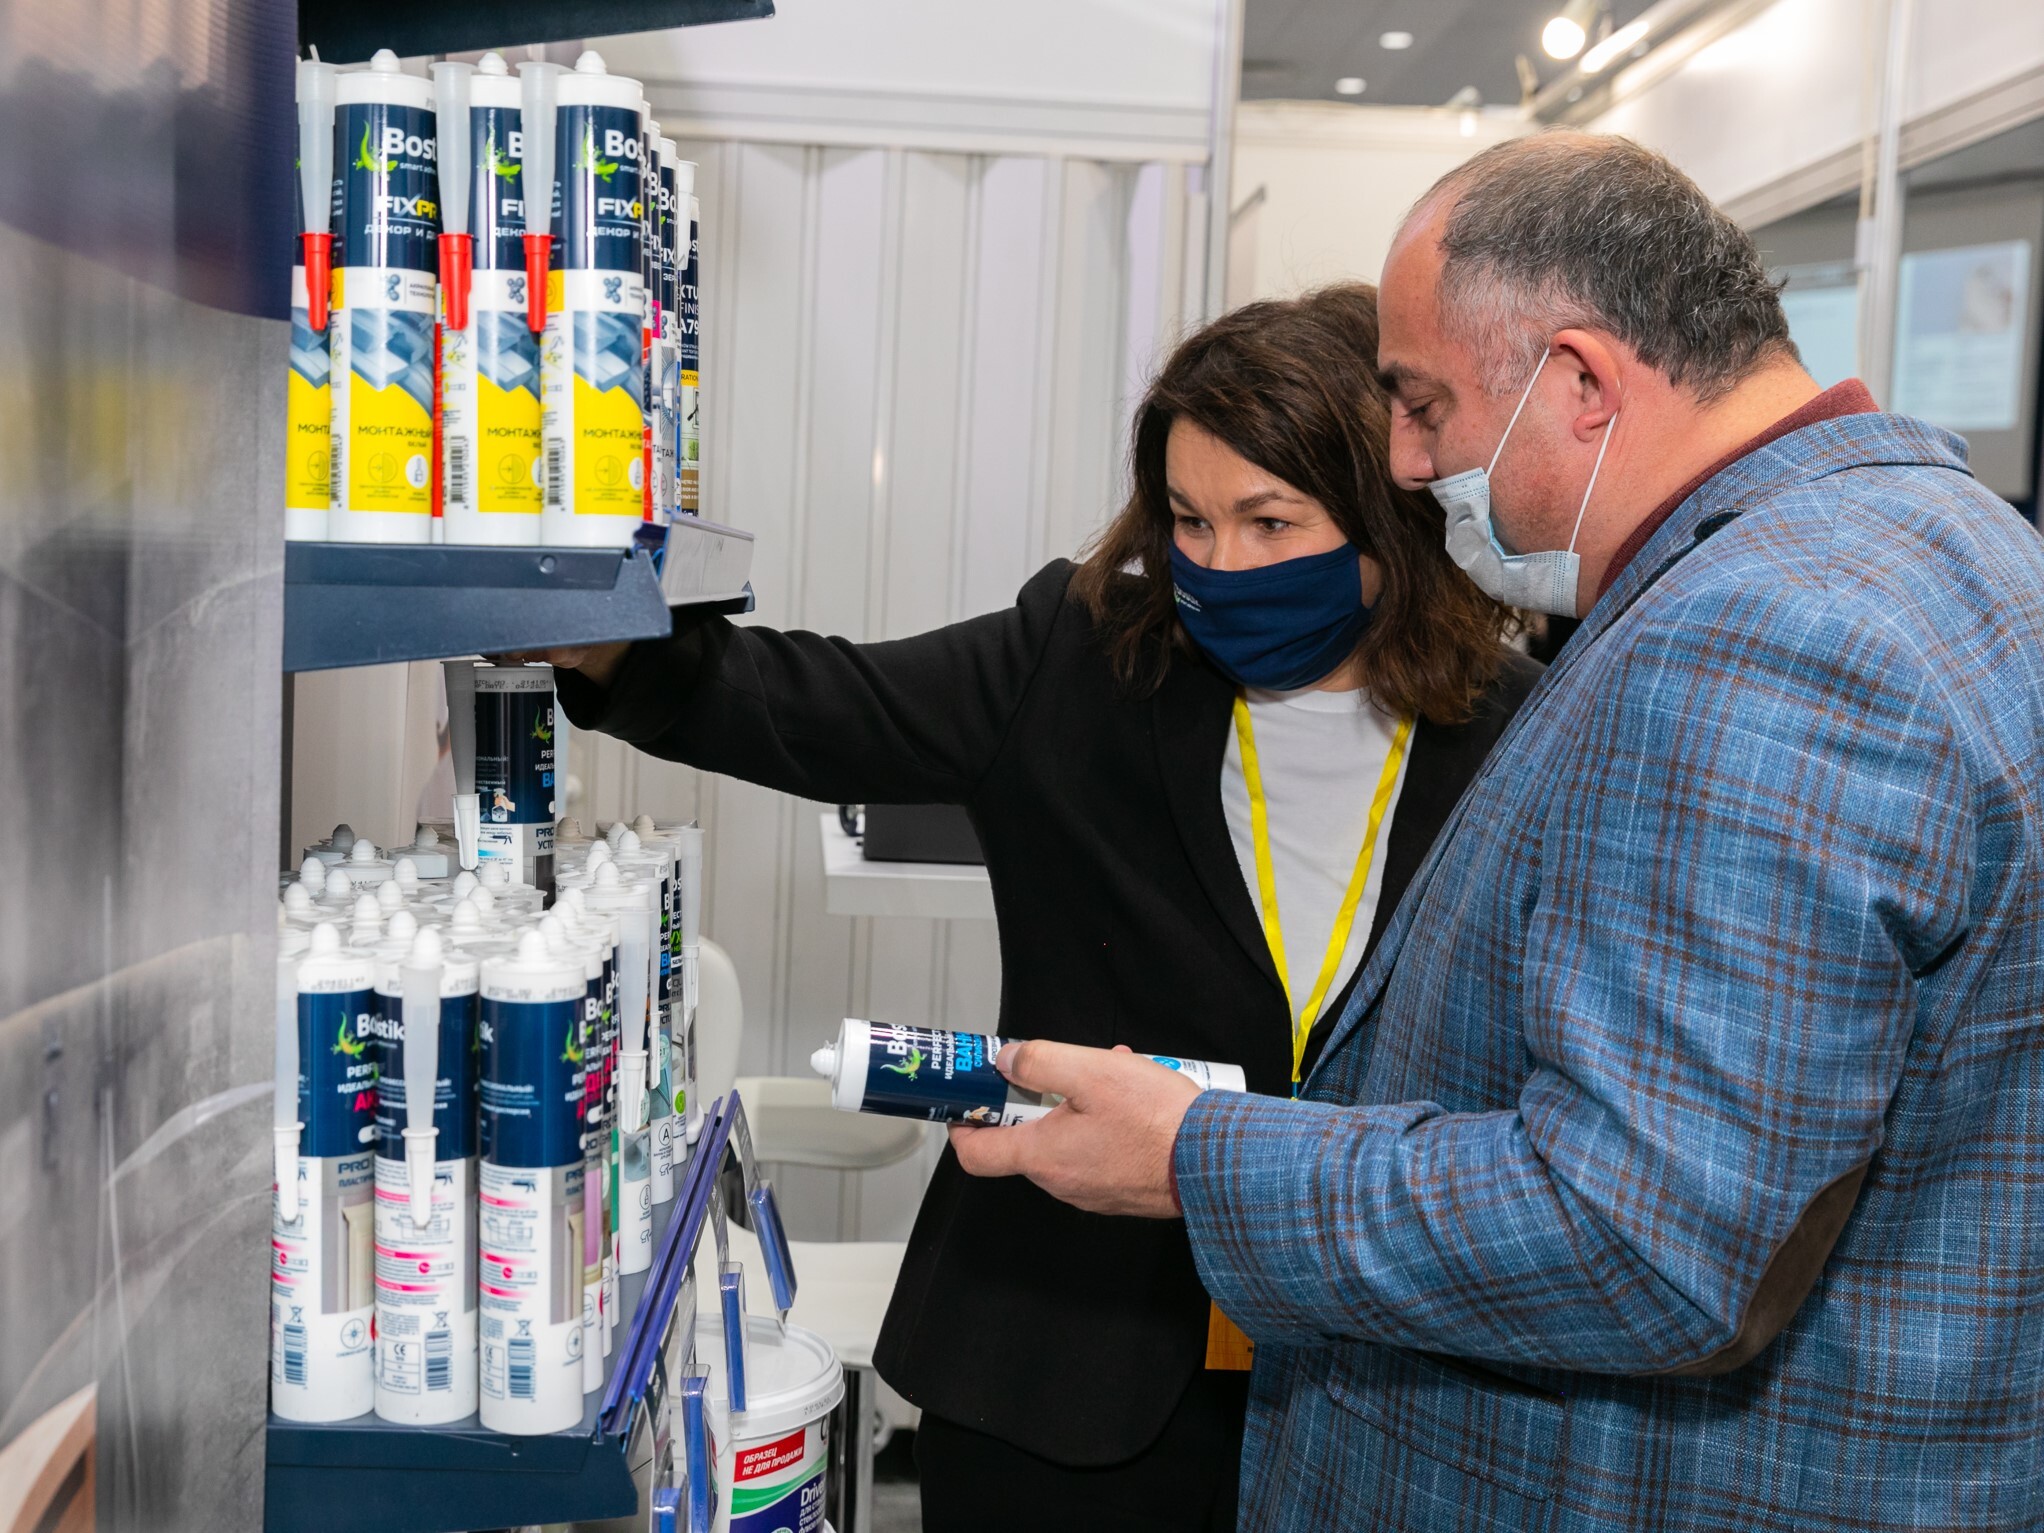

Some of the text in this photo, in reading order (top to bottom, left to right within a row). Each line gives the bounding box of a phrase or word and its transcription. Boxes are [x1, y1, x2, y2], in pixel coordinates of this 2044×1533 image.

[742, 1446, 803, 1476] НЕ ДЛЯ ПРОДАЖИ
[743, 1447, 777, 1465] ОБРАЗЕЦ
